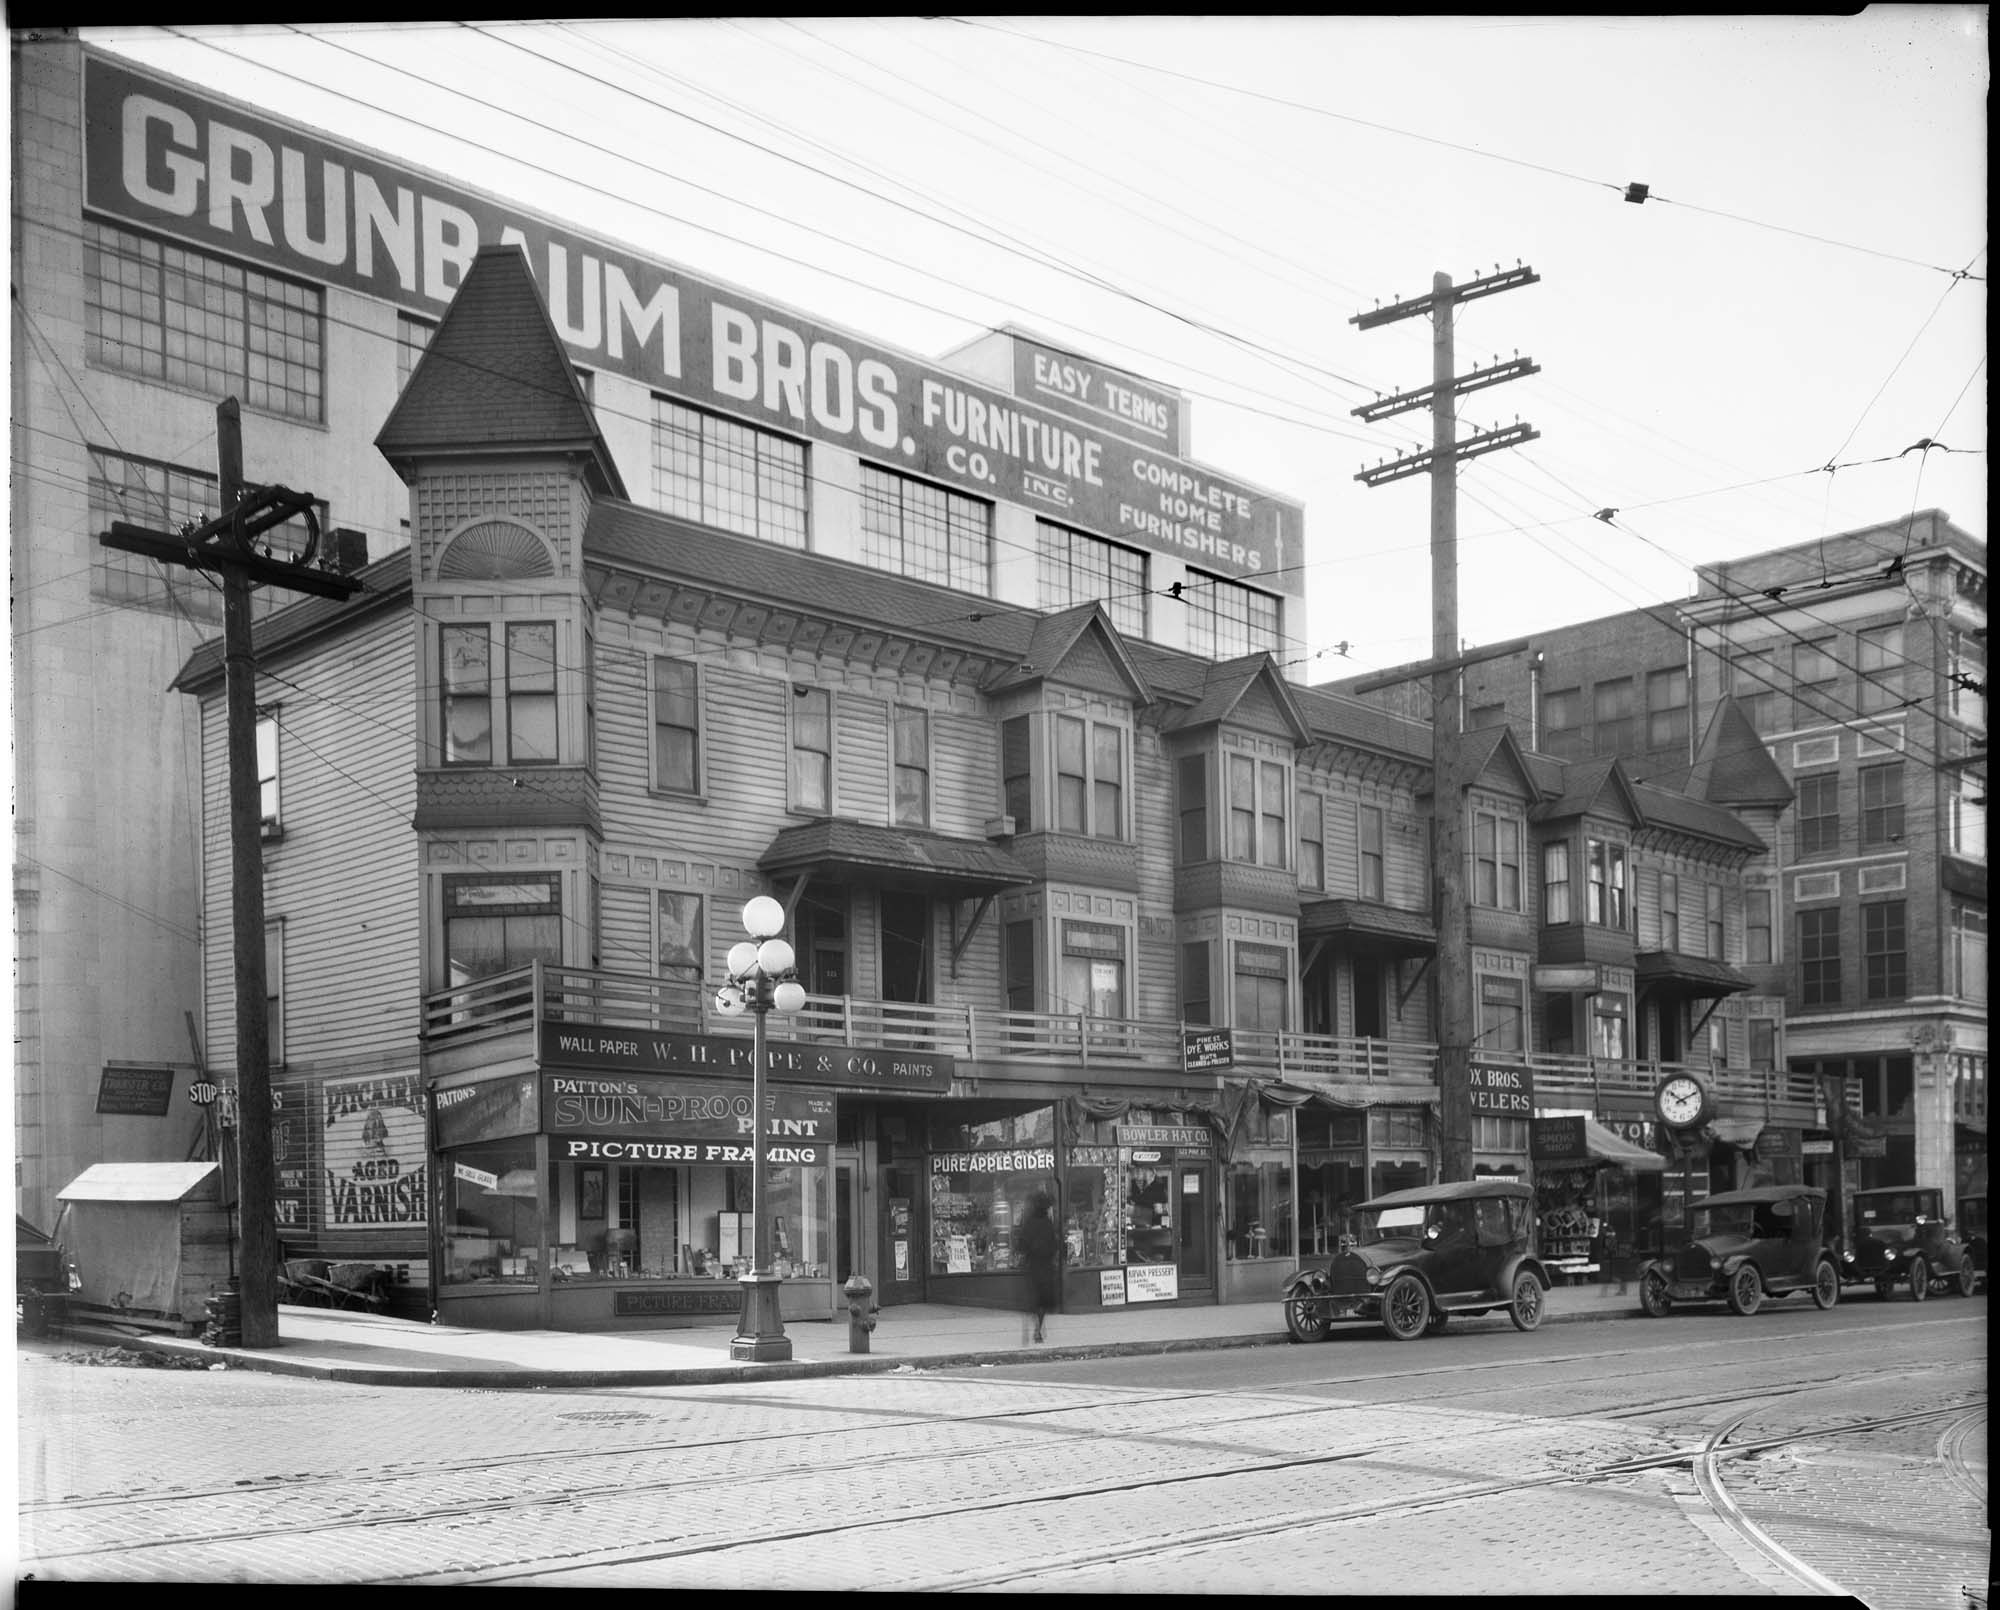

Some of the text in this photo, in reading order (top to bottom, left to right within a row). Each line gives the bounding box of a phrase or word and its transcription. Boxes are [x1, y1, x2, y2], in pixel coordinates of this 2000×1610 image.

[711, 301, 916, 458] BROS.
[1034, 353, 1168, 433] EASY TERMS
[922, 379, 1103, 488] FURNITURE
[947, 446, 997, 485] CO.
[1024, 476, 1074, 505] INC.
[1132, 458, 1251, 520] COMPLETE
[1159, 492, 1222, 532] HOME
[1119, 504, 1261, 571] FURNISHERS
[559, 1035, 595, 1053] WALL
[600, 1039, 639, 1057] PAPER
[652, 1041, 677, 1060] W.
[691, 1044, 717, 1064] H.
[816, 1055, 832, 1072] &
[848, 1056, 882, 1076] CO.
[893, 1062, 933, 1078] PAINTS
[1187, 1040, 1229, 1055] DYE WORKS
[189, 1082, 217, 1103] STOP
[553, 1079, 638, 1094] PATTON'S
[1488, 1071, 1522, 1089] BROS.
[436, 1087, 477, 1110] PATTON'S
[1122, 1129, 1209, 1142] BOWLER HAT CO.
[568, 1141, 697, 1160] PICTURE
[933, 1154, 1055, 1173] PURE APPLE CIDER
[352, 1158, 399, 1181] AGED
[327, 1164, 426, 1224] VARNISH
